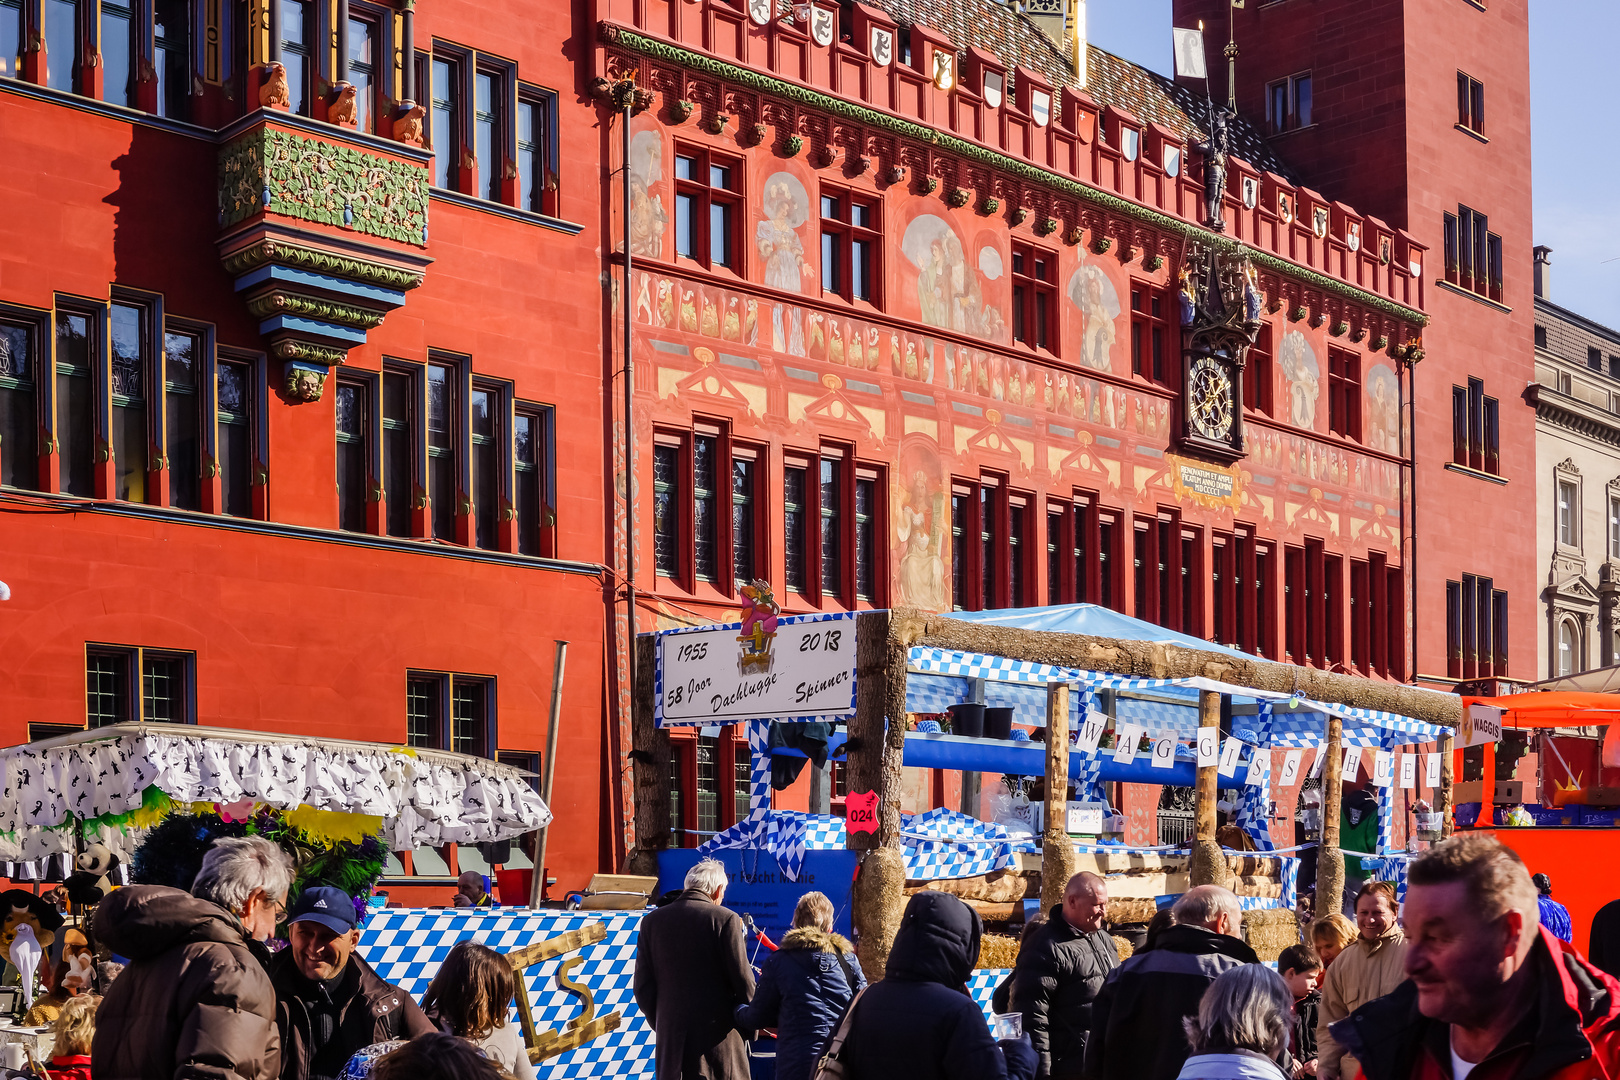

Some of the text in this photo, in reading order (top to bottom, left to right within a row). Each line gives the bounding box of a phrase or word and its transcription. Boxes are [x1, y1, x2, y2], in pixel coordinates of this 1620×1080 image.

[1180, 465, 1233, 484] RENOVATUM ET AMPLI
[1202, 479, 1216, 488] ANNO
[1216, 482, 1232, 491] DOMINI
[677, 642, 709, 662] 1955
[667, 685, 683, 708] 58
[688, 677, 712, 703] Joor
[1473, 718, 1500, 739] WAGGIS
[850, 810, 873, 822] 024
